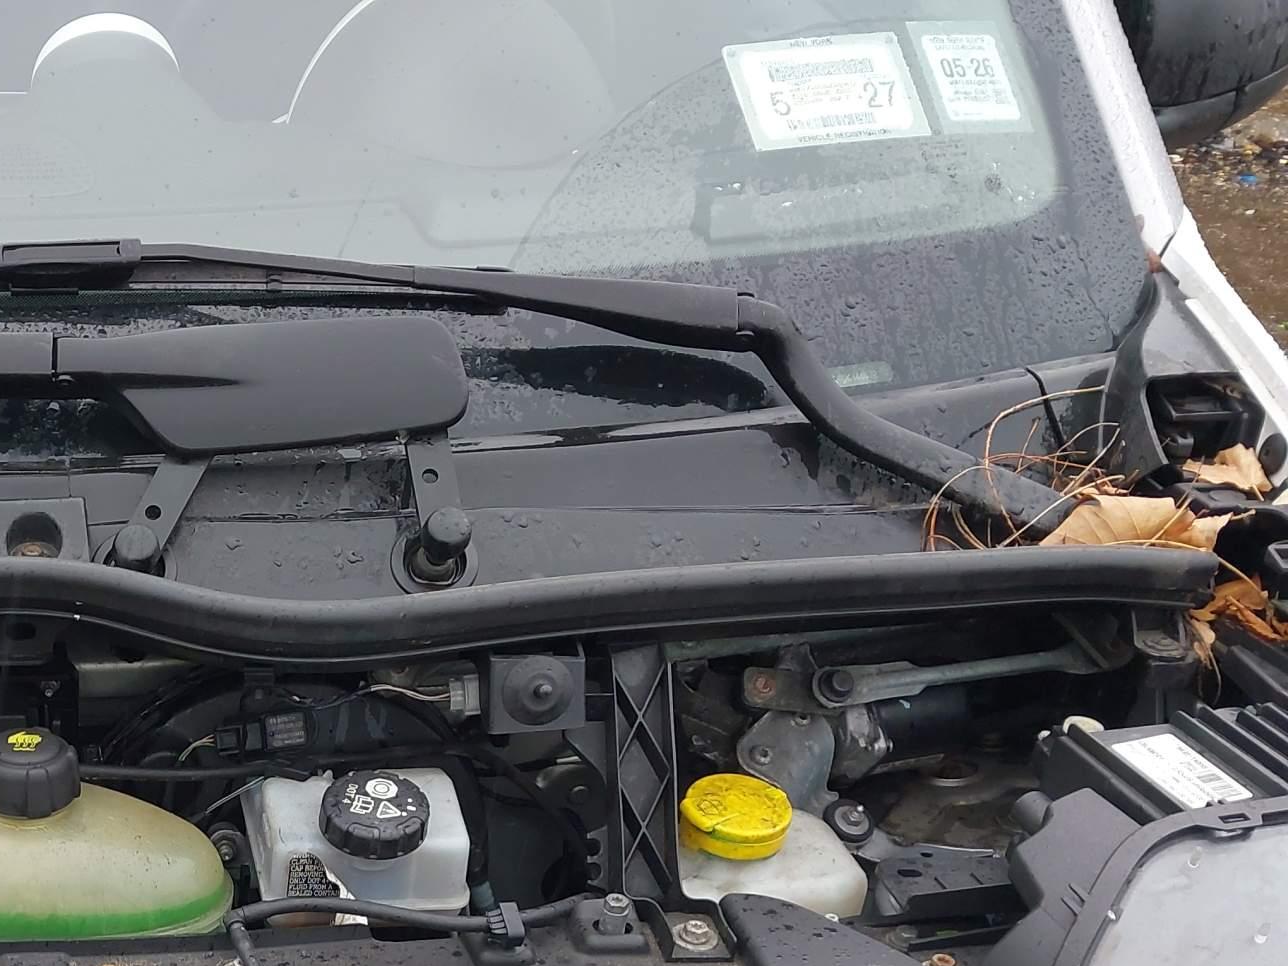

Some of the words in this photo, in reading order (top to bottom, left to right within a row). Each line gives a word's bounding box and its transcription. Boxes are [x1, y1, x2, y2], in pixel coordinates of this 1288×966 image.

[770, 91, 791, 116] 5
[863, 80, 896, 108] 27
[344, 783, 359, 799] DOT
